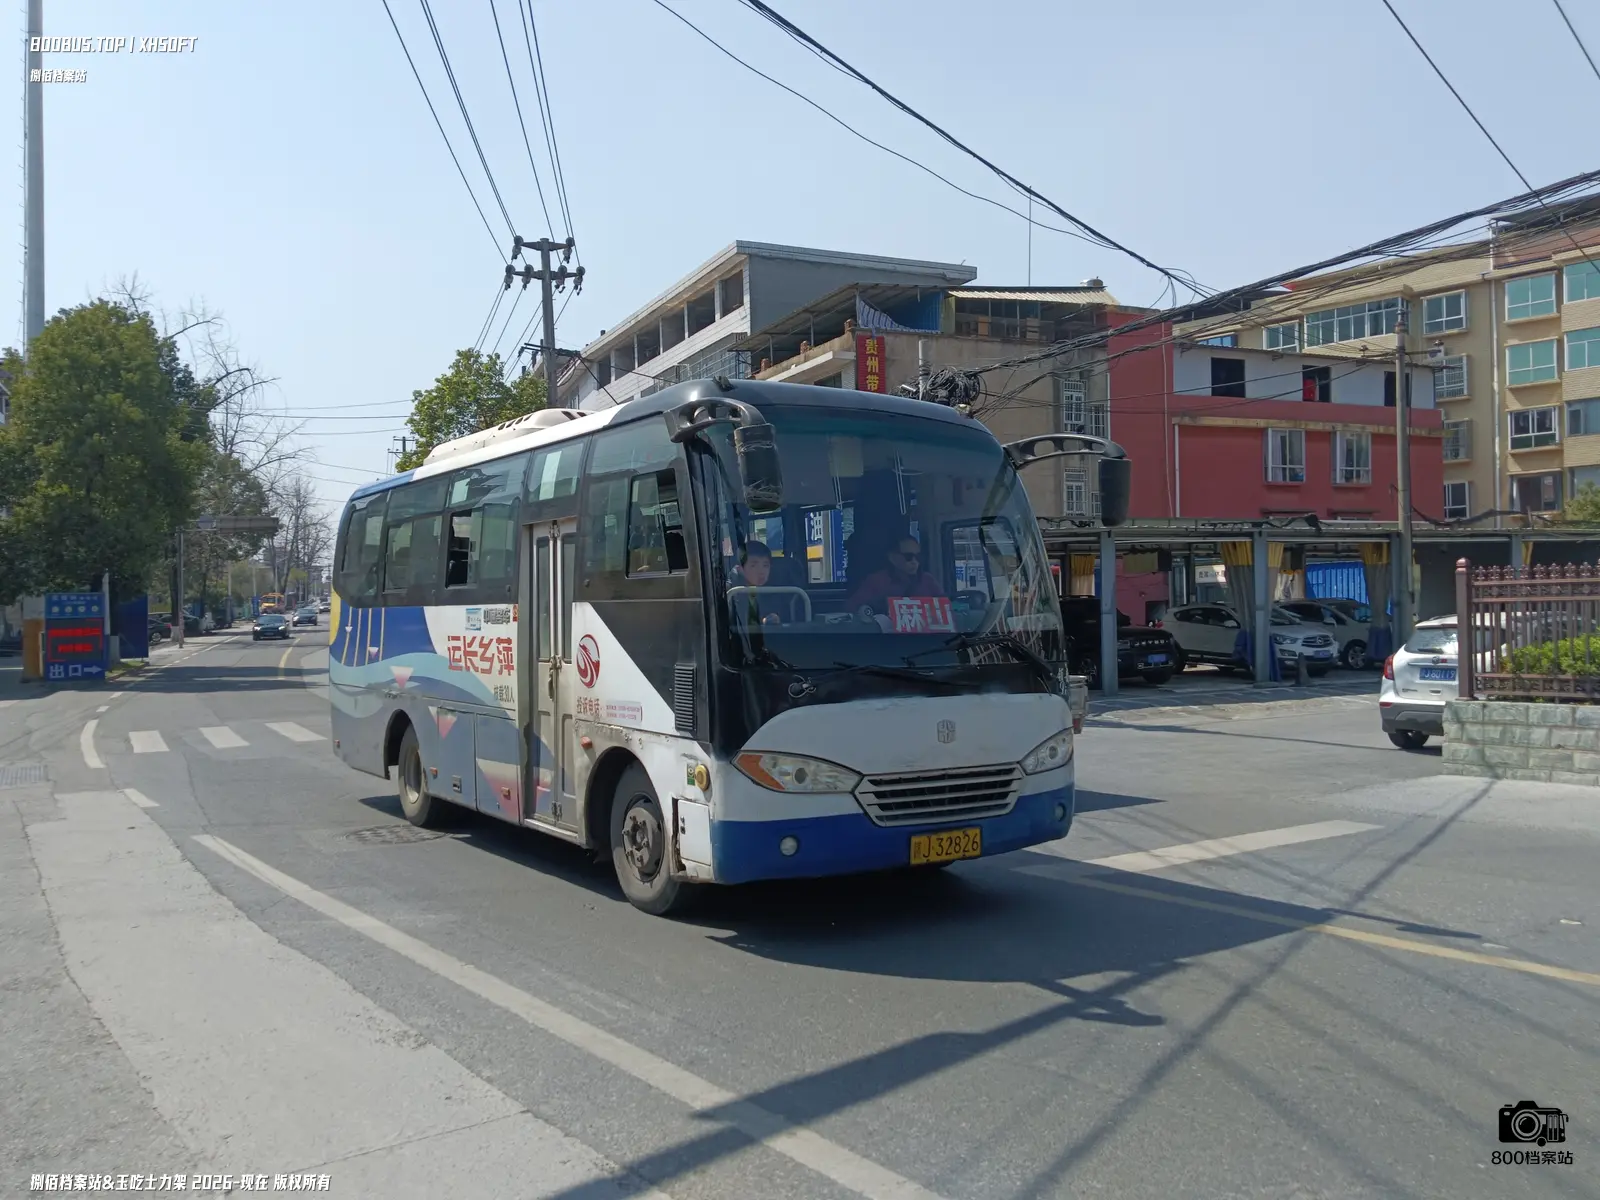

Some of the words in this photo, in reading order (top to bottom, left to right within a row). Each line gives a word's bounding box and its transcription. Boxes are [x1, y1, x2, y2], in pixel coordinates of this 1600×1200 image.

[865, 338, 880, 391] 贵州带
[893, 597, 956, 632] 麻山
[49, 664, 82, 679] 出口
[1421, 668, 1455, 679] J80119
